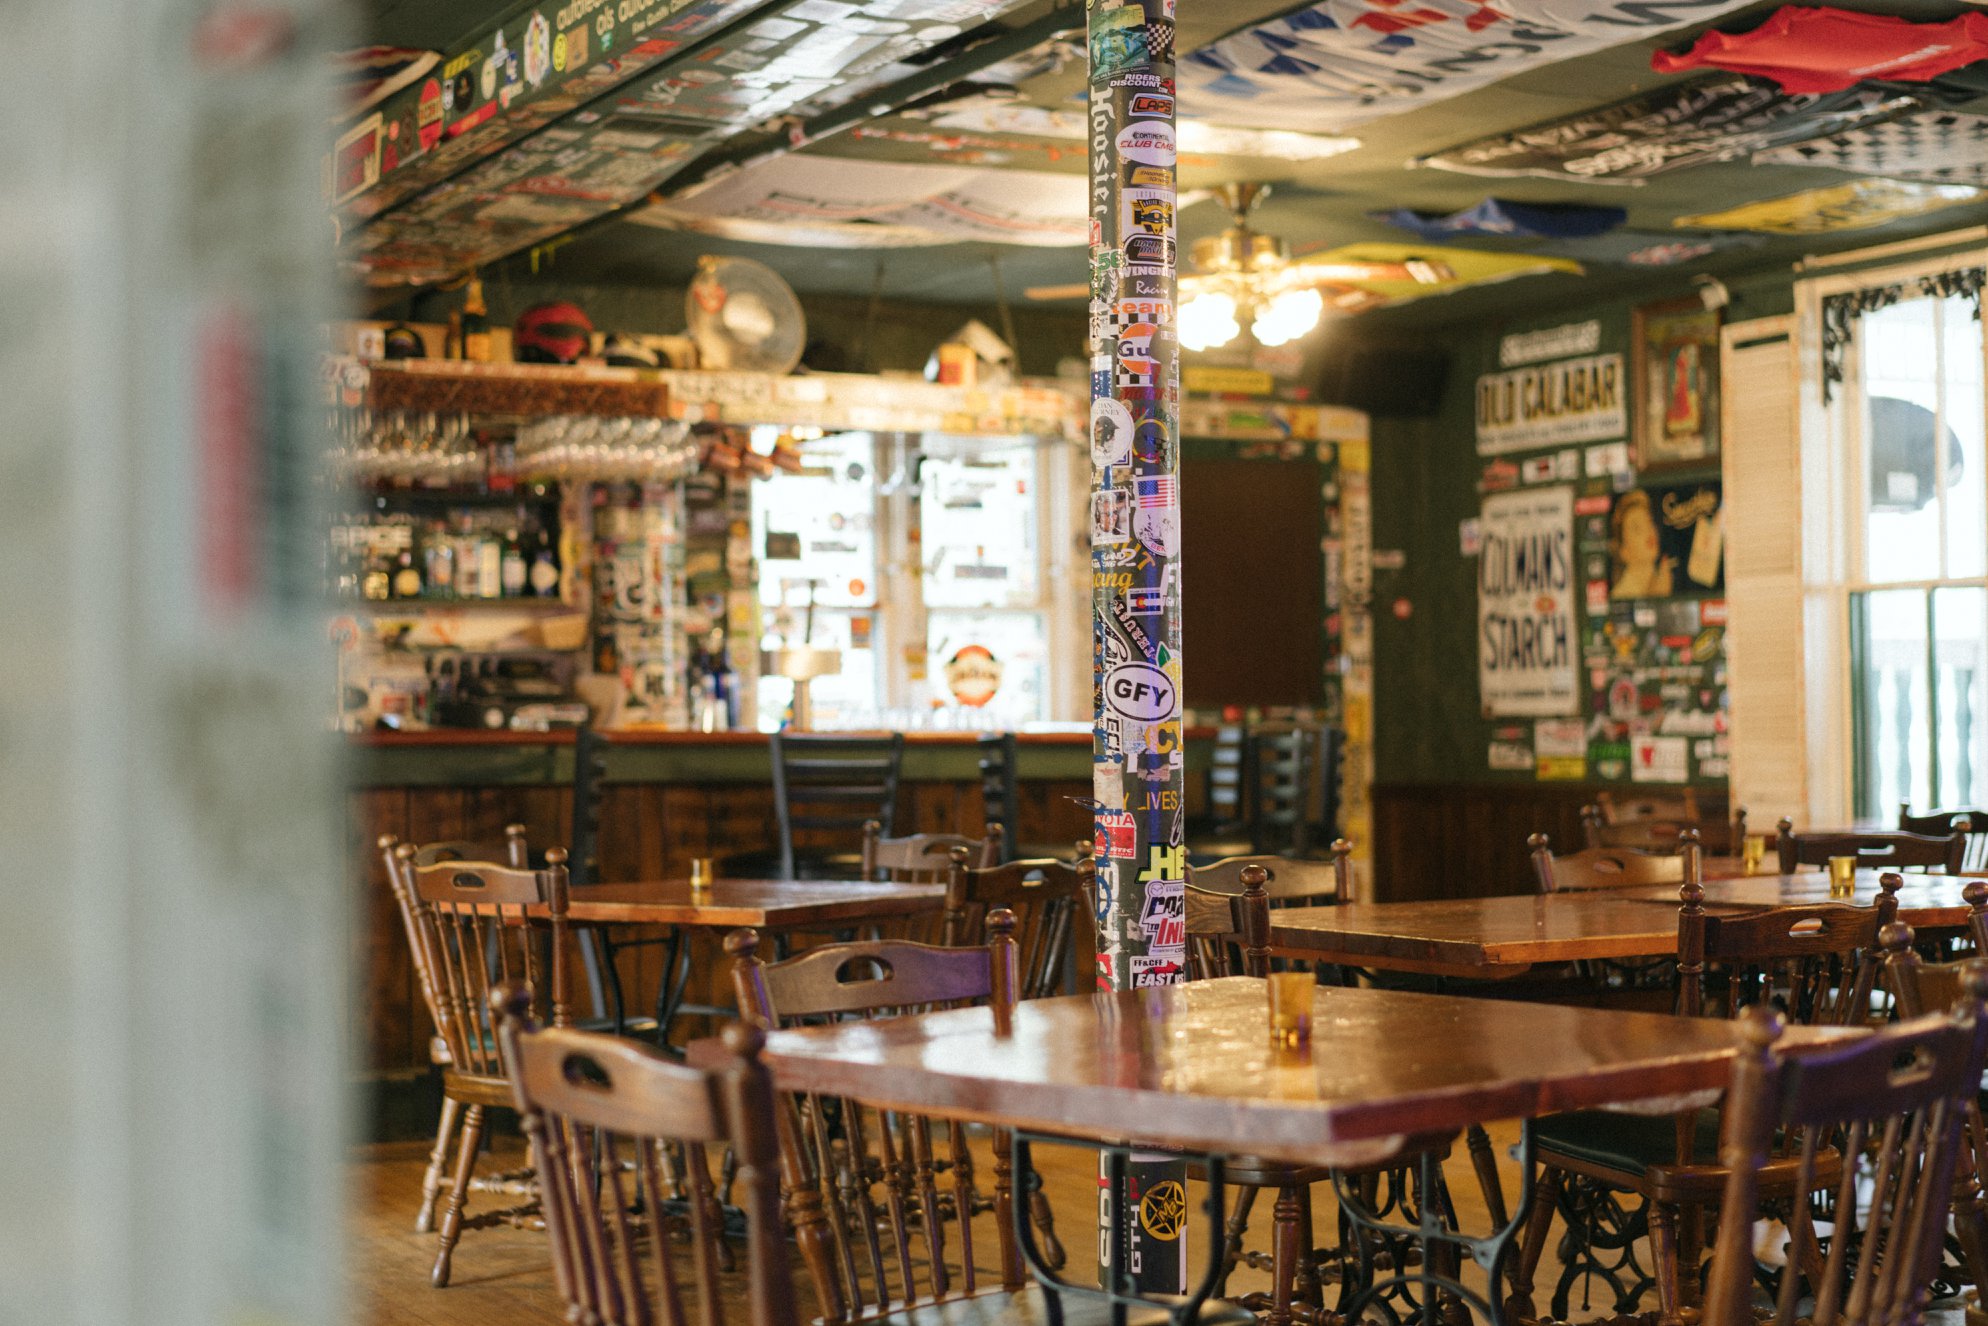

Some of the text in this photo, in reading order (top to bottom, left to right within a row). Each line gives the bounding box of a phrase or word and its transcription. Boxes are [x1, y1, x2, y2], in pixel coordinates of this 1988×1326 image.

[1110, 79, 1161, 88] DISCOUNT
[1125, 73, 1161, 82] RIDERS
[1136, 97, 1172, 116] LAPS
[1090, 84, 1118, 215] Hoosier
[1120, 140, 1174, 151] CLUB CMG
[1483, 611, 1569, 673] STARCH
[1113, 678, 1169, 708] GFY
[1135, 973, 1174, 987] EAST
